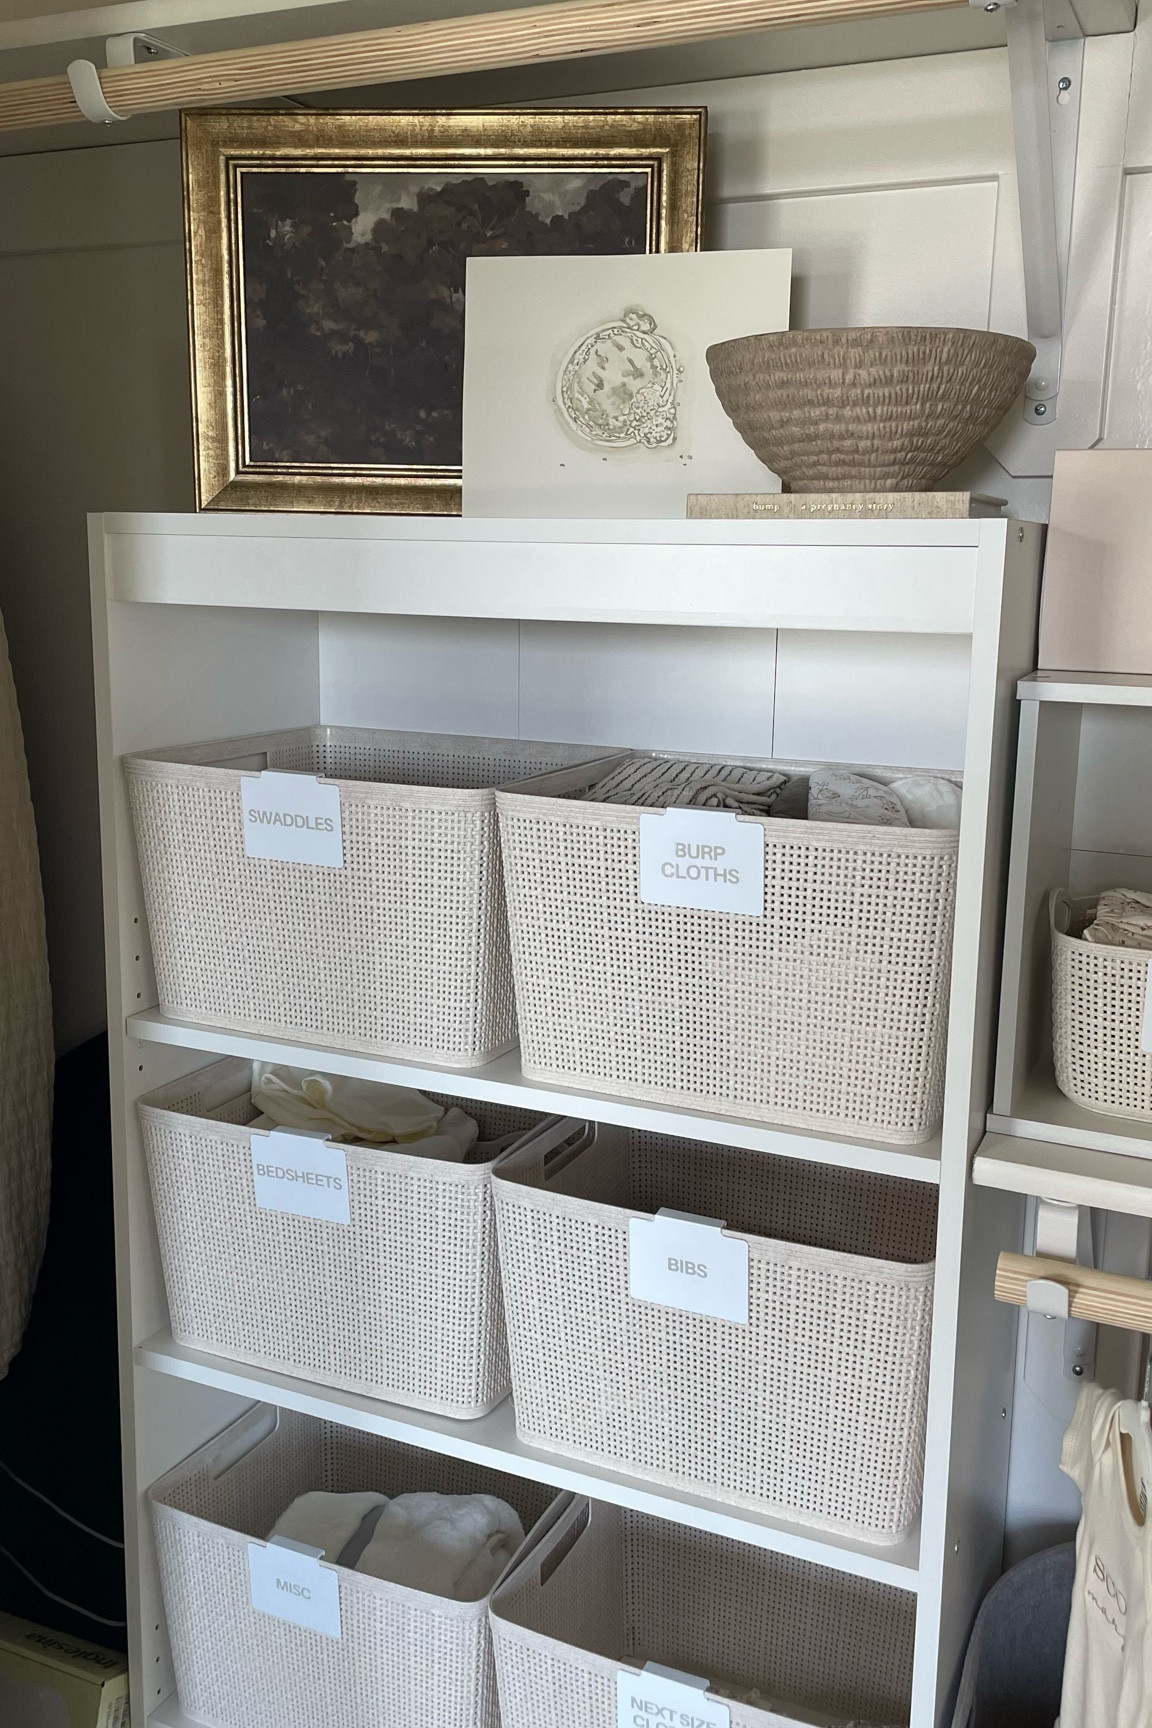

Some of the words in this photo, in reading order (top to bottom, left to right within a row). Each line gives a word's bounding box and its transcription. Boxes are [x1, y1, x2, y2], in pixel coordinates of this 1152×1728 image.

[753, 501, 780, 513] bump
[800, 503, 806, 511] a
[868, 501, 894, 513] story
[248, 808, 334, 832] SWADDLES
[675, 842, 726, 861] BURP
[661, 862, 740, 885] CLOTHS
[256, 1163, 343, 1190] BEDSHEETS
[667, 1257, 708, 1279] BIBS
[276, 1578, 311, 1600] MISC
[630, 1695, 677, 1723] NEXT
